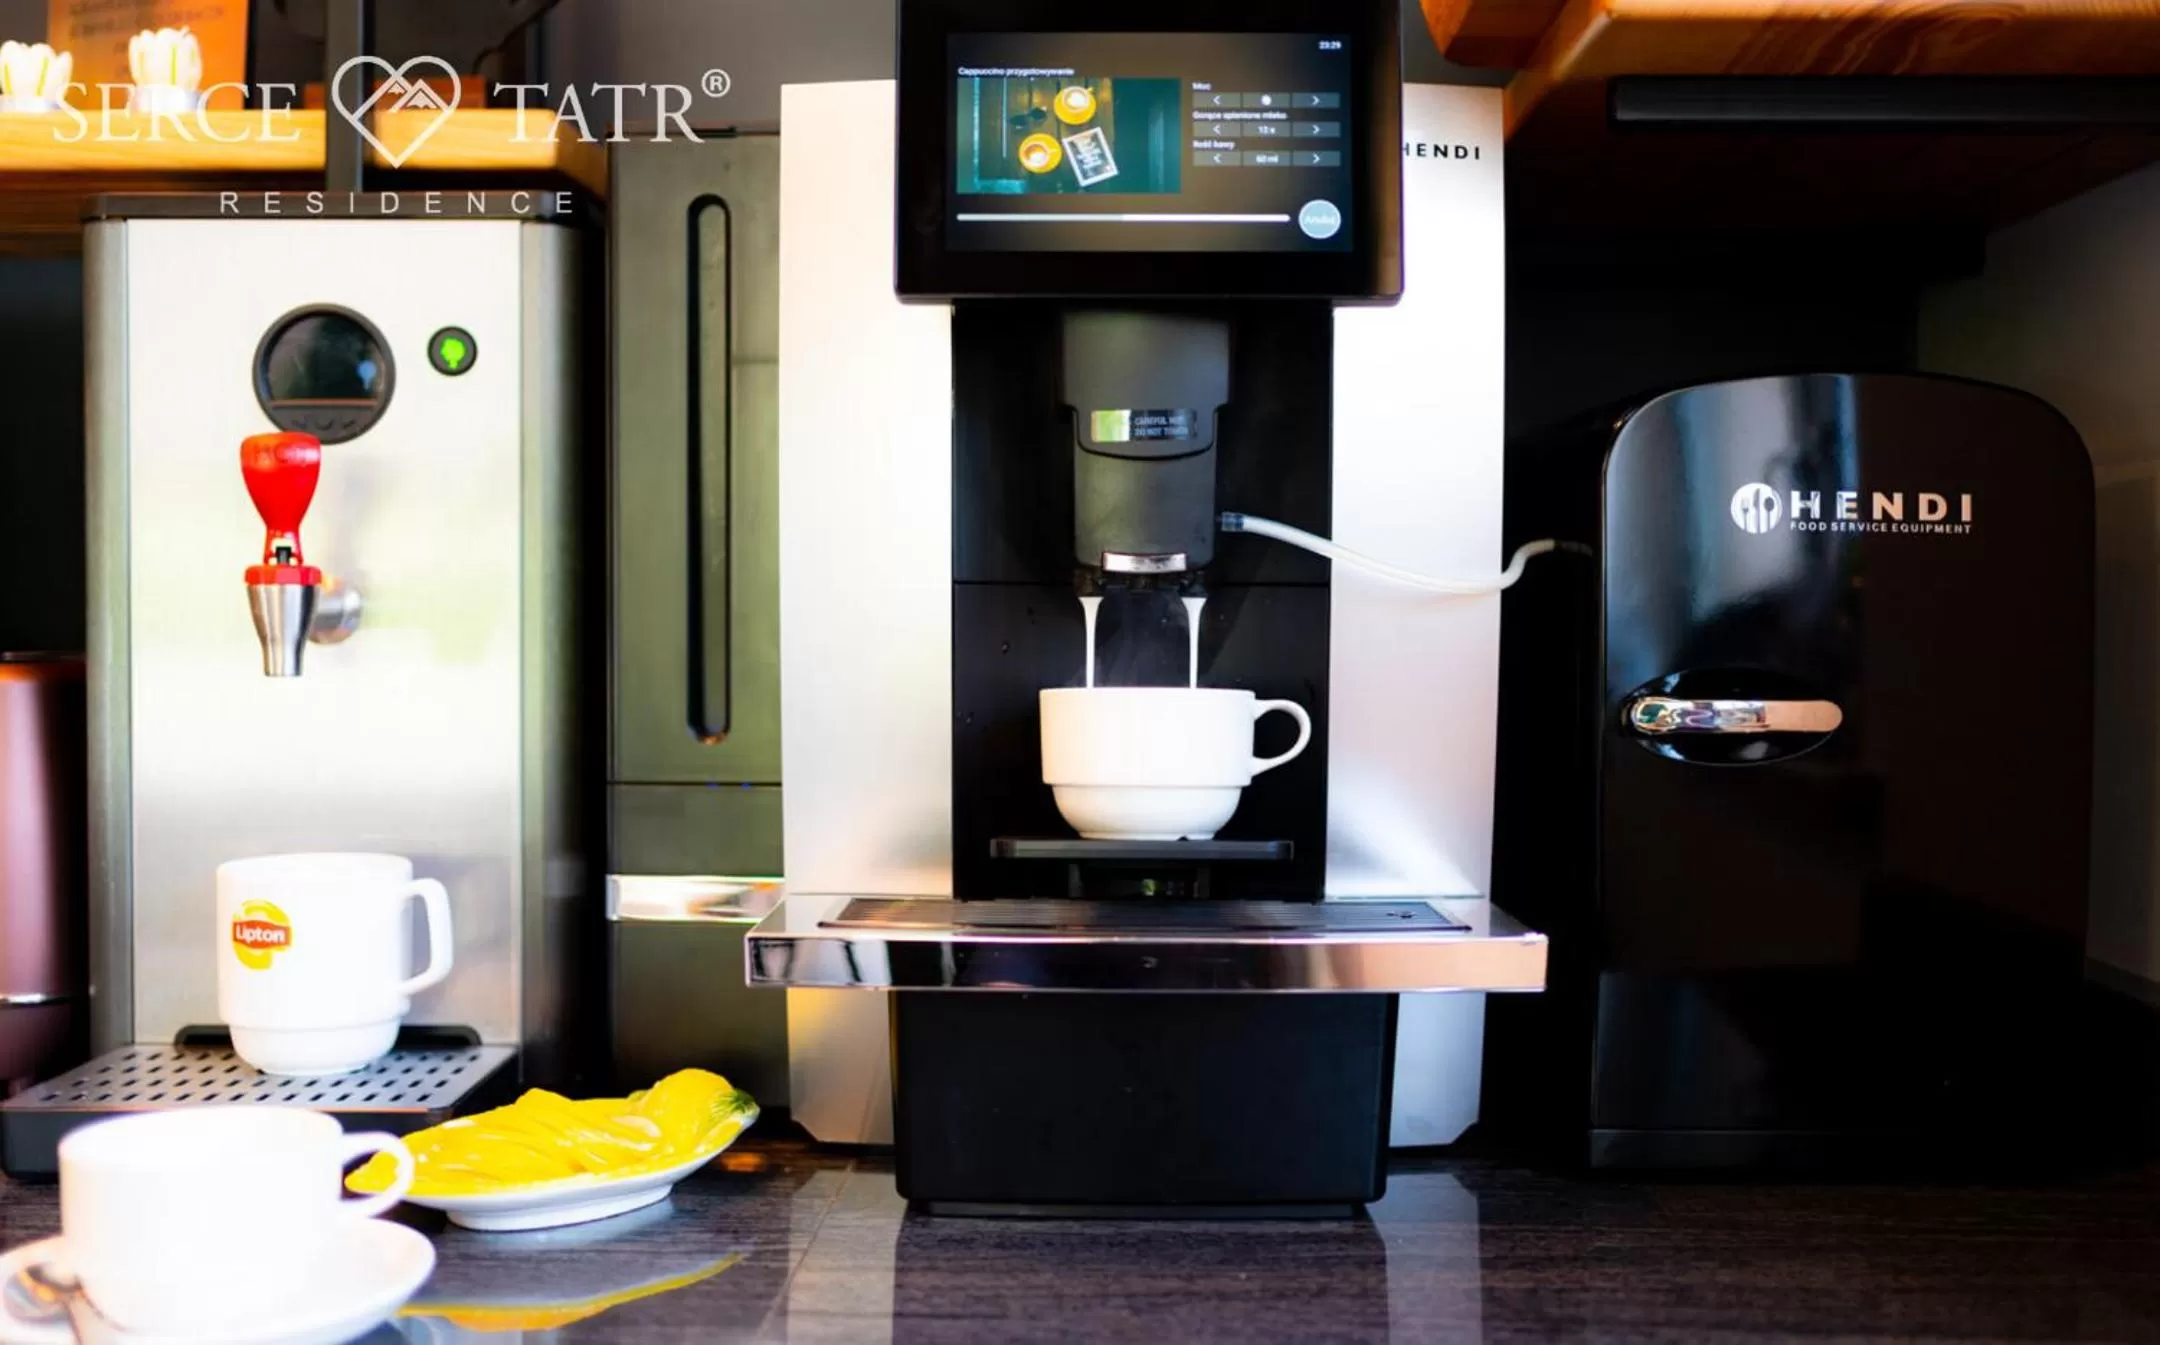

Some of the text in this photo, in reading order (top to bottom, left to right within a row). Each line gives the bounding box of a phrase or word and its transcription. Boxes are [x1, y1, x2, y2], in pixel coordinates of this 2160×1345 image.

[1790, 490, 1972, 522] HENDI
[1790, 521, 1972, 535] FOOD SERVICE EQUIPMENT
[236, 923, 286, 945] Lipton
